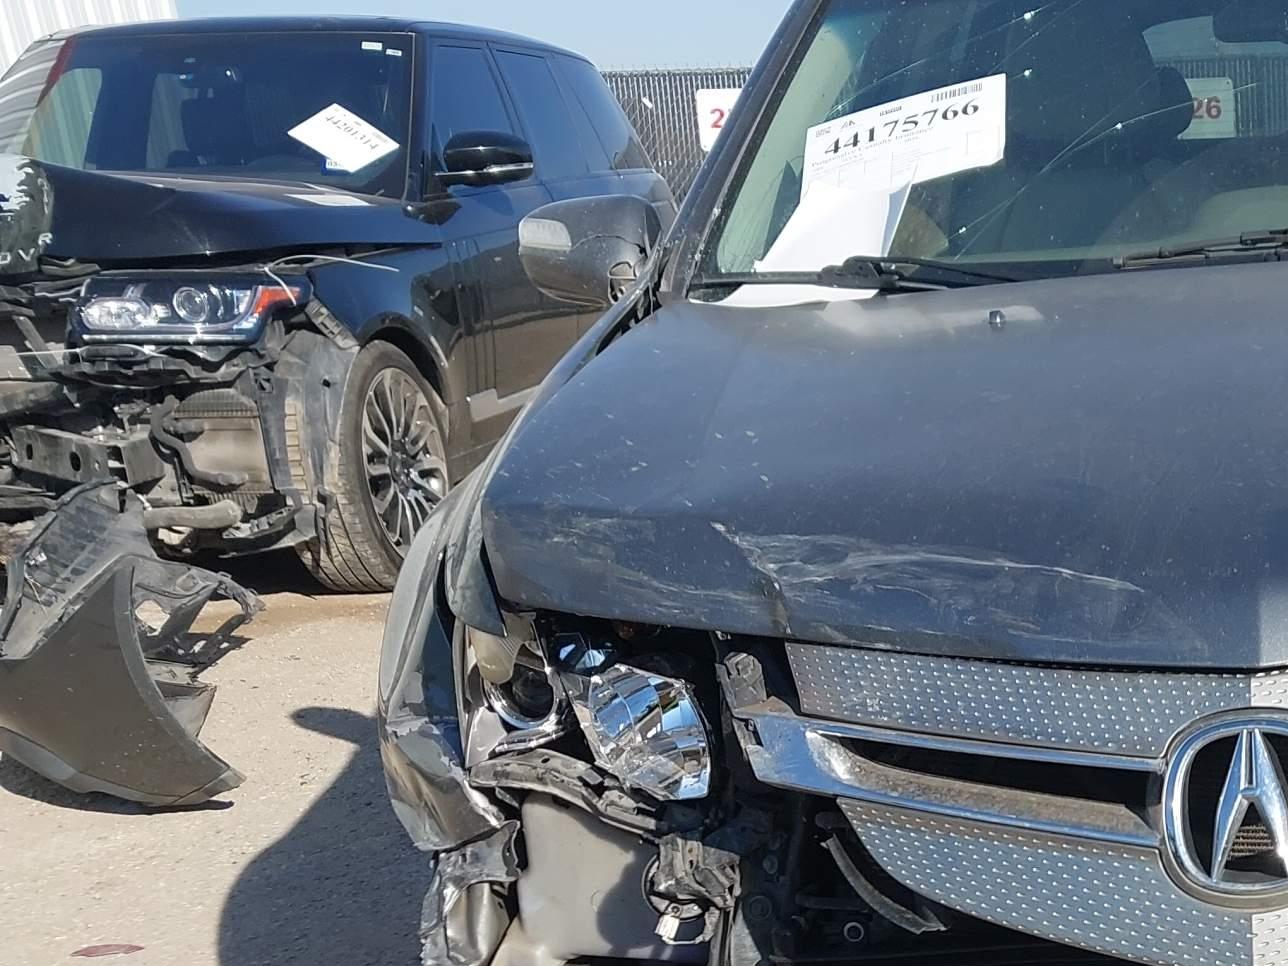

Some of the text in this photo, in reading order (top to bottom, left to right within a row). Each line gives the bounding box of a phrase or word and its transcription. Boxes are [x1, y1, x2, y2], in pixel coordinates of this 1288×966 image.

[710, 108, 726, 129] 2
[1192, 96, 1221, 119] 26
[824, 98, 981, 155] 44175766
